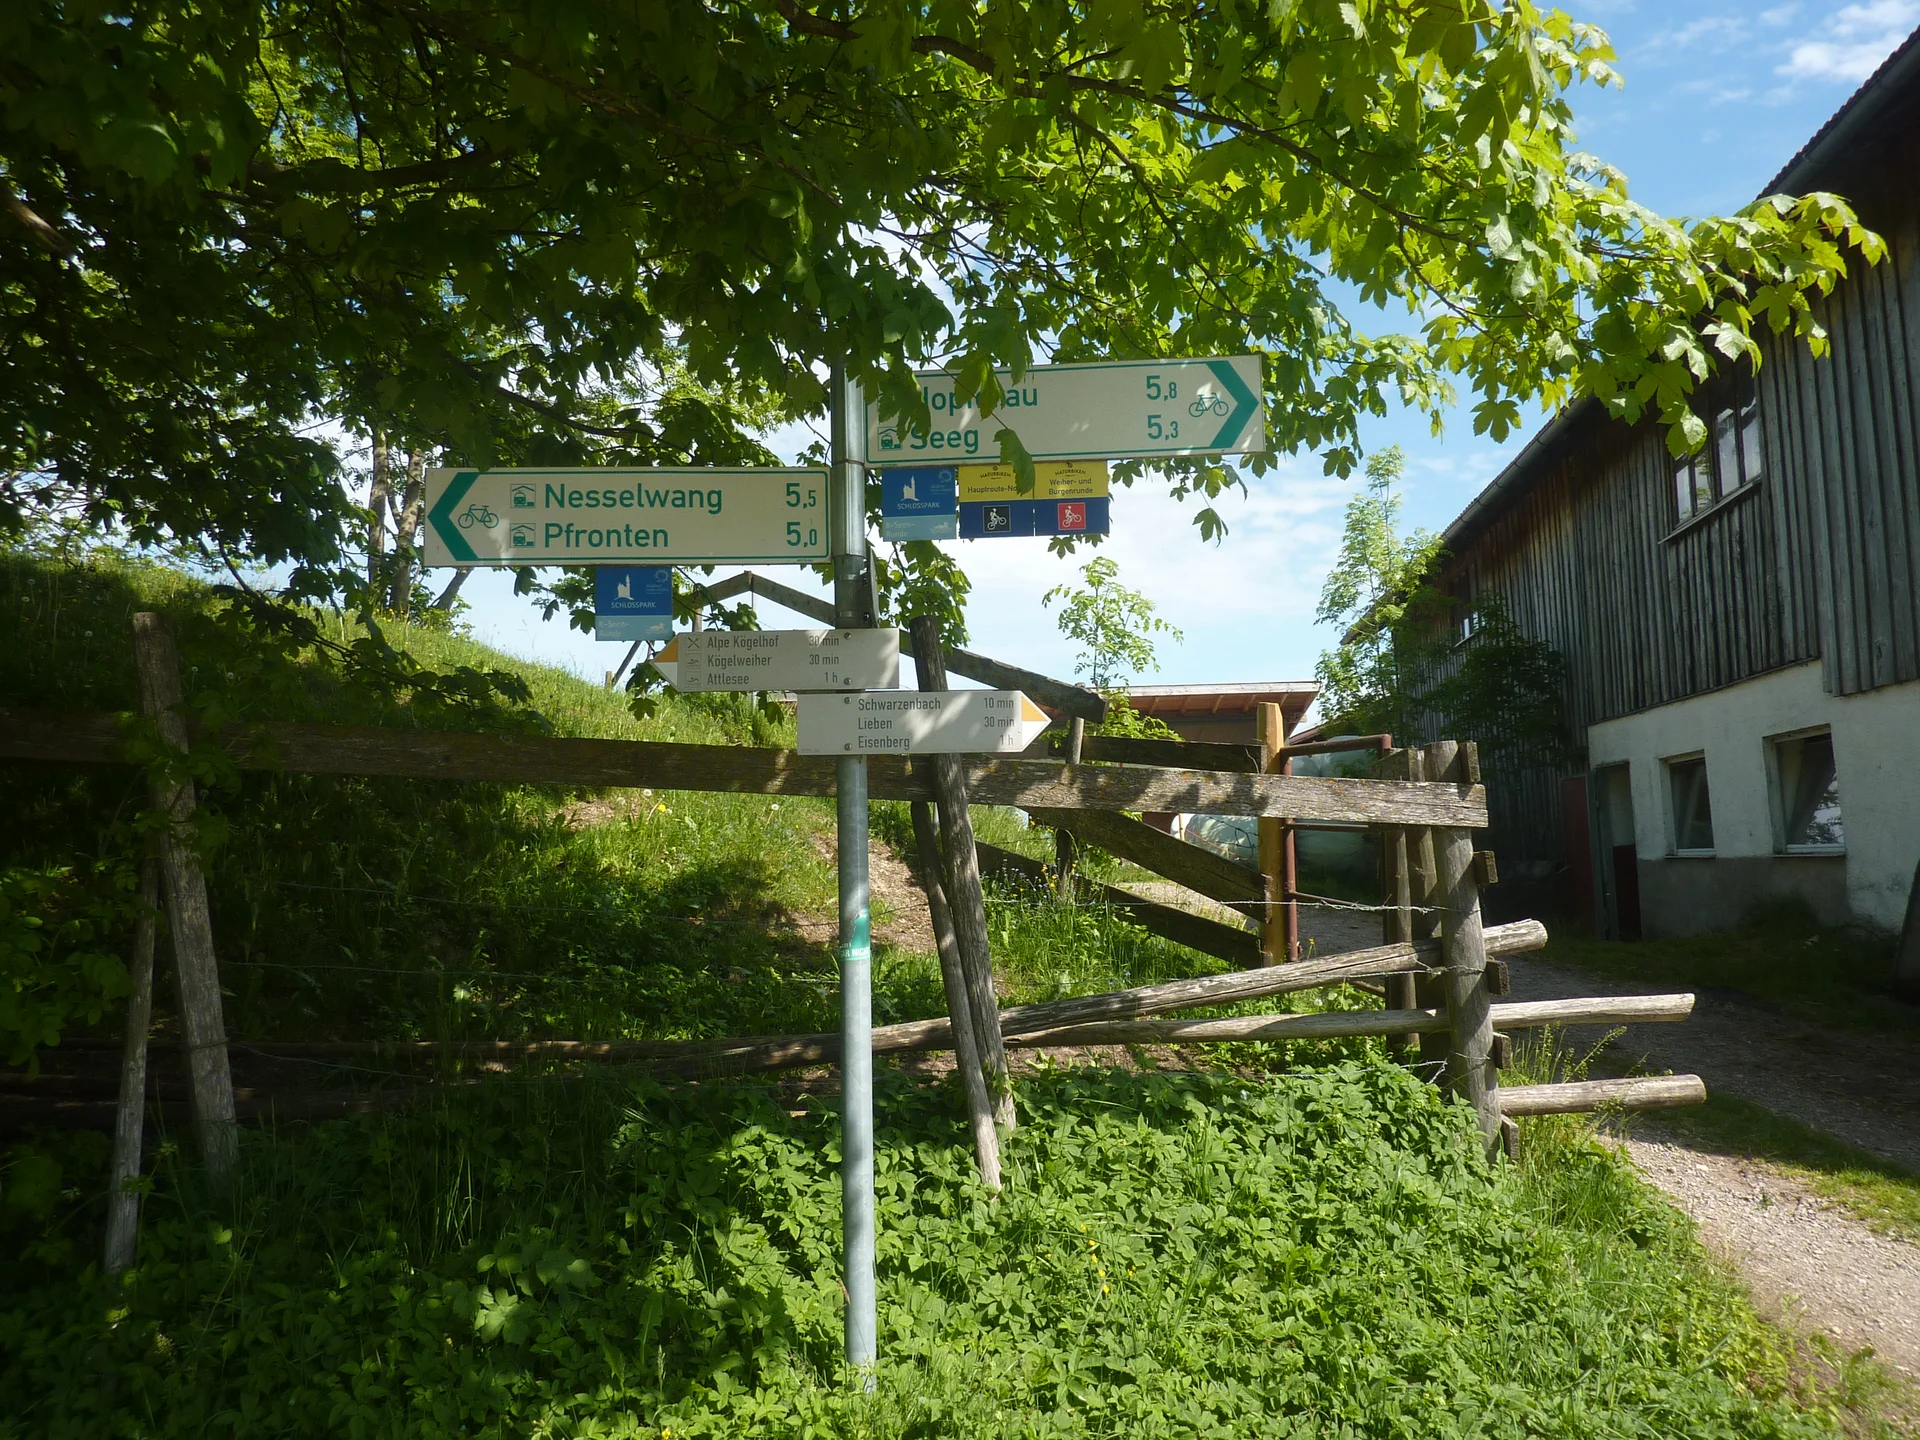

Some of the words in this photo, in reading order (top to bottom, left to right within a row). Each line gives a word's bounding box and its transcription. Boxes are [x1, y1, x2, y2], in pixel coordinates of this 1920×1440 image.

[1146, 375, 1177, 402] 5,8
[1147, 414, 1179, 440] 5,3
[910, 423, 979, 454] Seeg
[967, 485, 1018, 494] Hauptroute-No
[1048, 487, 1093, 496] Burgenrunde
[545, 483, 722, 515] Nesselwang
[786, 483, 816, 510] 5,5
[897, 502, 940, 510] SCHLOSSPARK
[545, 523, 668, 548] Pfronten
[786, 522, 817, 548] 5,0
[707, 636, 730, 651] Alpe
[734, 634, 780, 650] Kögelhof
[809, 635, 820, 647] 30
[823, 634, 840, 647] min
[707, 654, 772, 669] Kögelweiher
[809, 654, 820, 665] 30
[823, 653, 840, 665] min
[707, 672, 750, 685] Attlesee
[824, 672, 829, 683] 1
[831, 672, 838, 683] h
[858, 698, 941, 711] Schwarzenbach
[984, 697, 995, 709] 10
[996, 697, 1014, 709] min
[858, 717, 893, 730] Lieben
[984, 716, 995, 728] 30
[997, 716, 1015, 728] min
[858, 736, 911, 750] Eisenberg
[1000, 735, 1005, 746] 1
[1007, 735, 1014, 746] h
